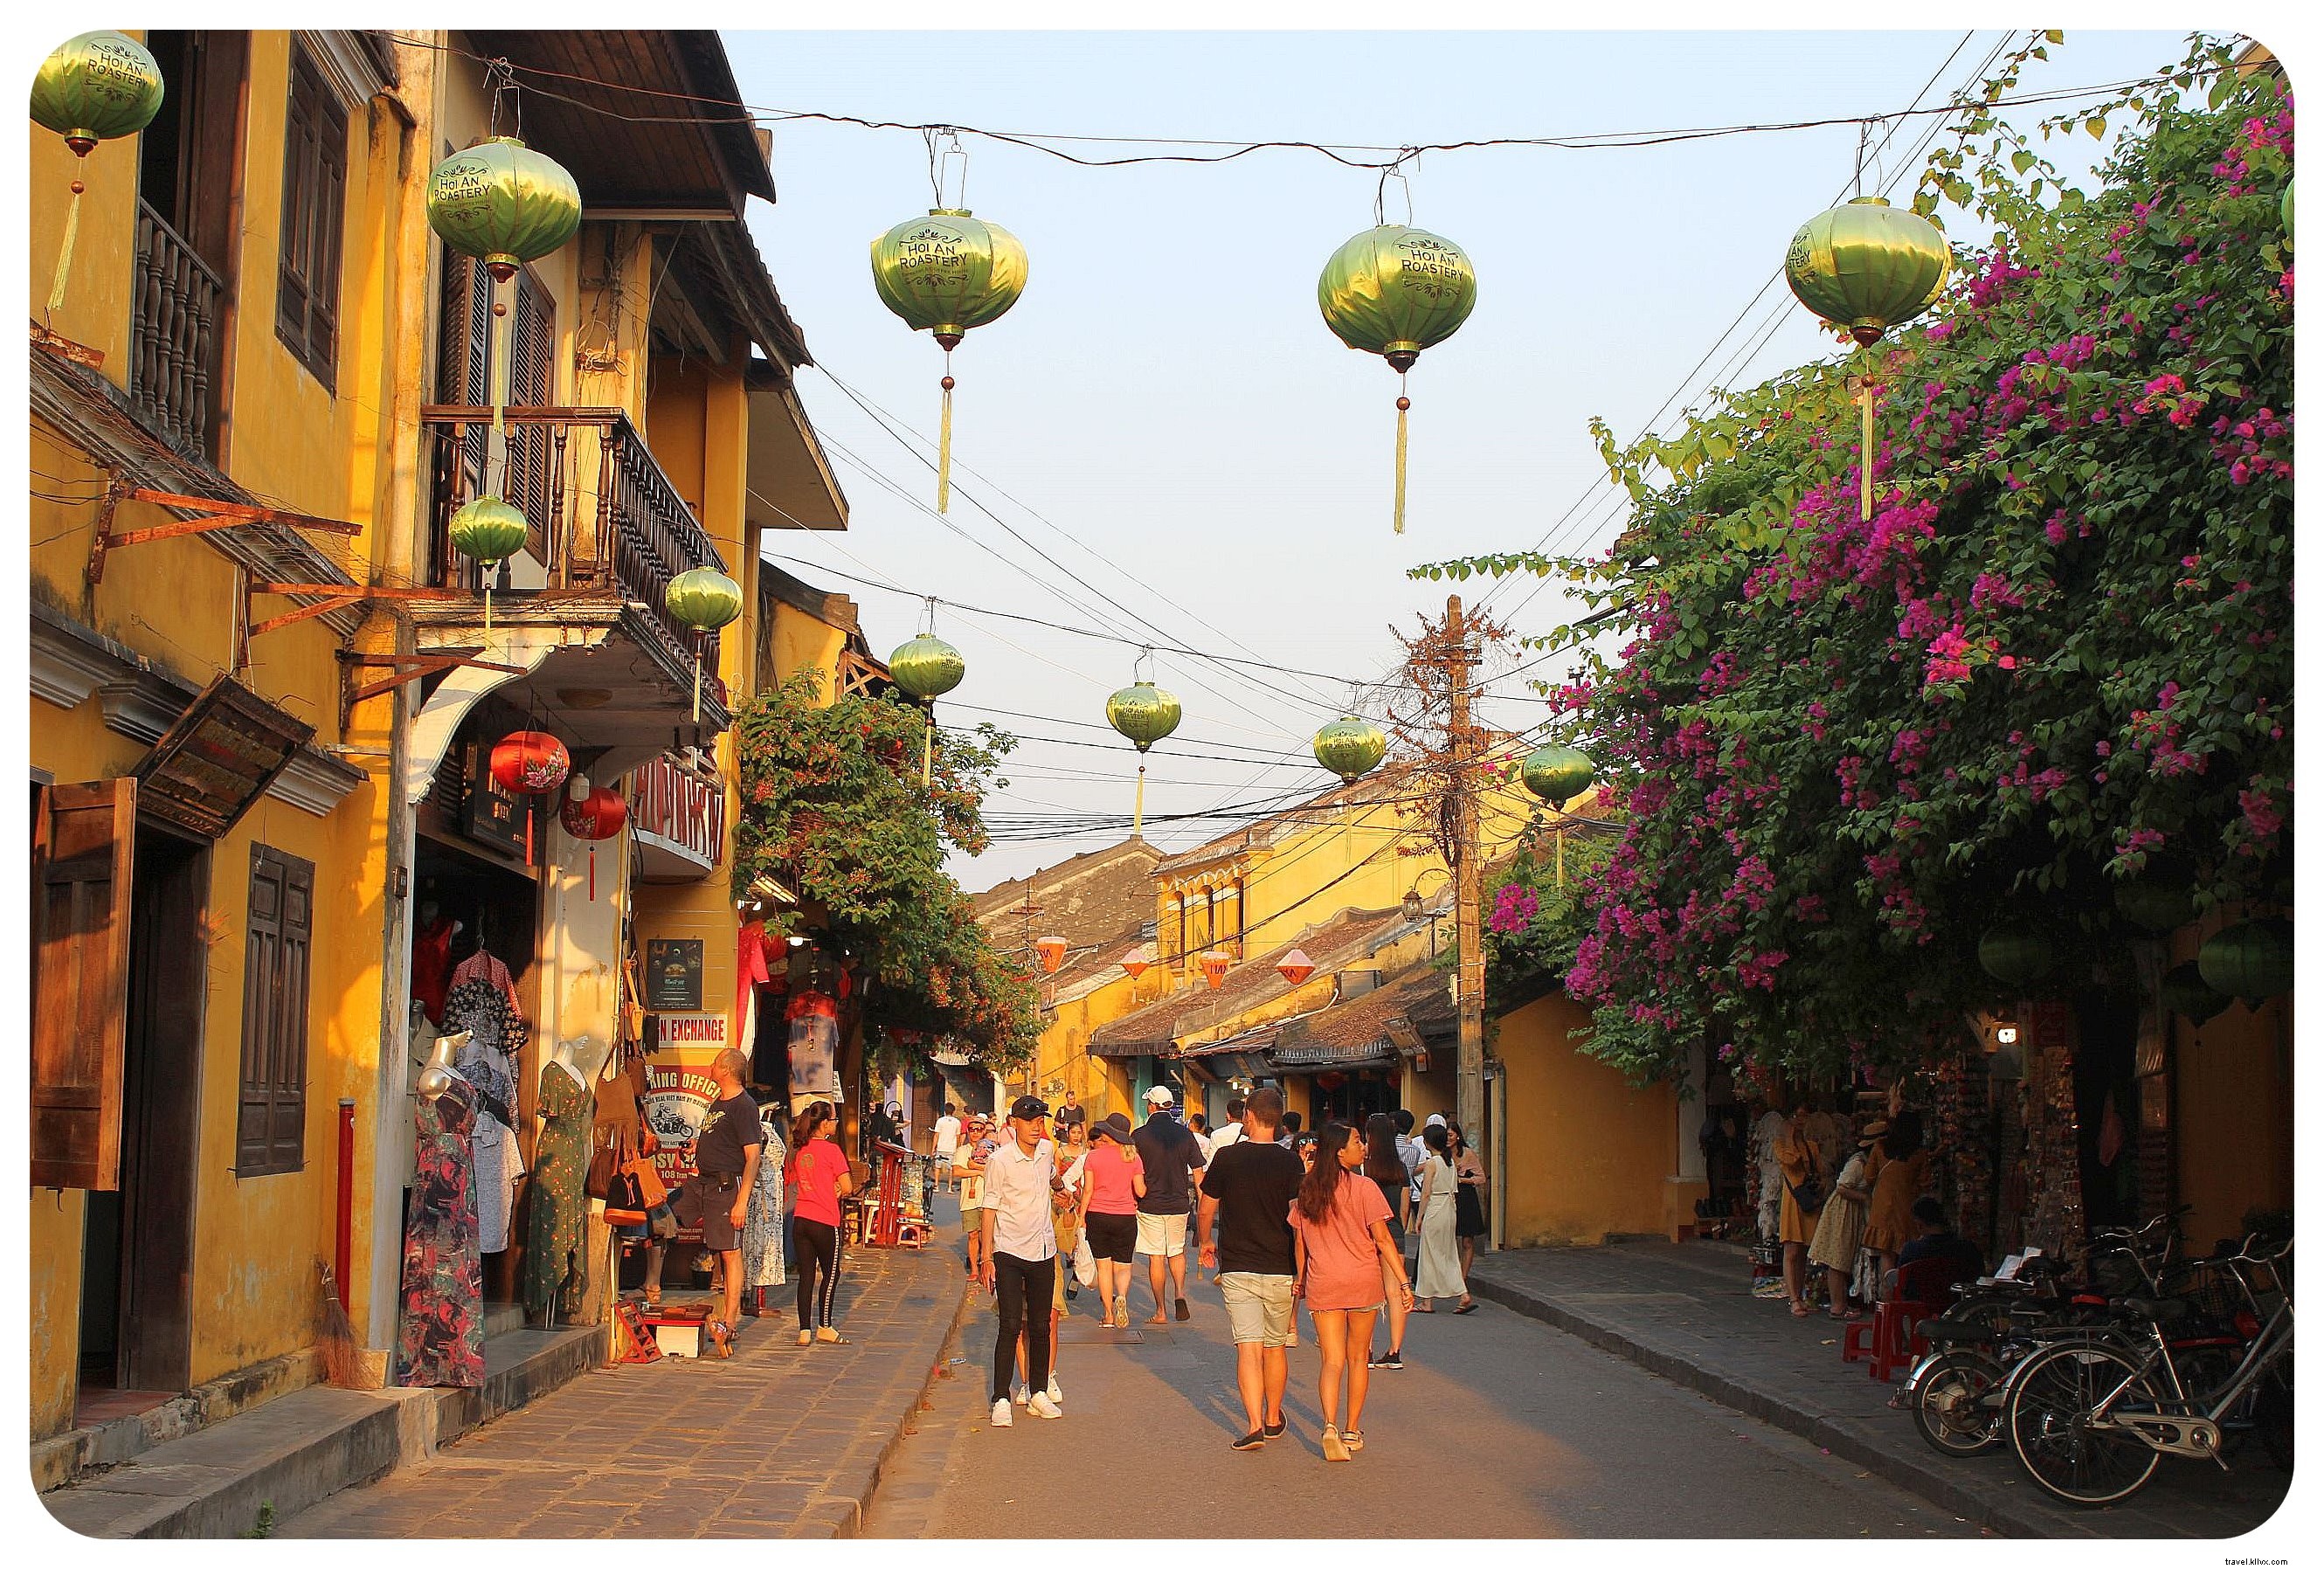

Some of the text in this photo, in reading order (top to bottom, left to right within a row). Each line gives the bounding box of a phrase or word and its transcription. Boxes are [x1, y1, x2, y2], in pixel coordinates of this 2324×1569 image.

[87, 59, 148, 88] ROASTERY
[127, 62, 143, 76] AN
[461, 176, 480, 188] AN
[435, 184, 489, 202] ROASTERY
[934, 244, 955, 256] AN
[900, 253, 968, 269] ROASTERY
[1440, 253, 1455, 267] AN
[1401, 259, 1463, 281] ROASTERY
[671, 1020, 724, 1041] EXCHANGE
